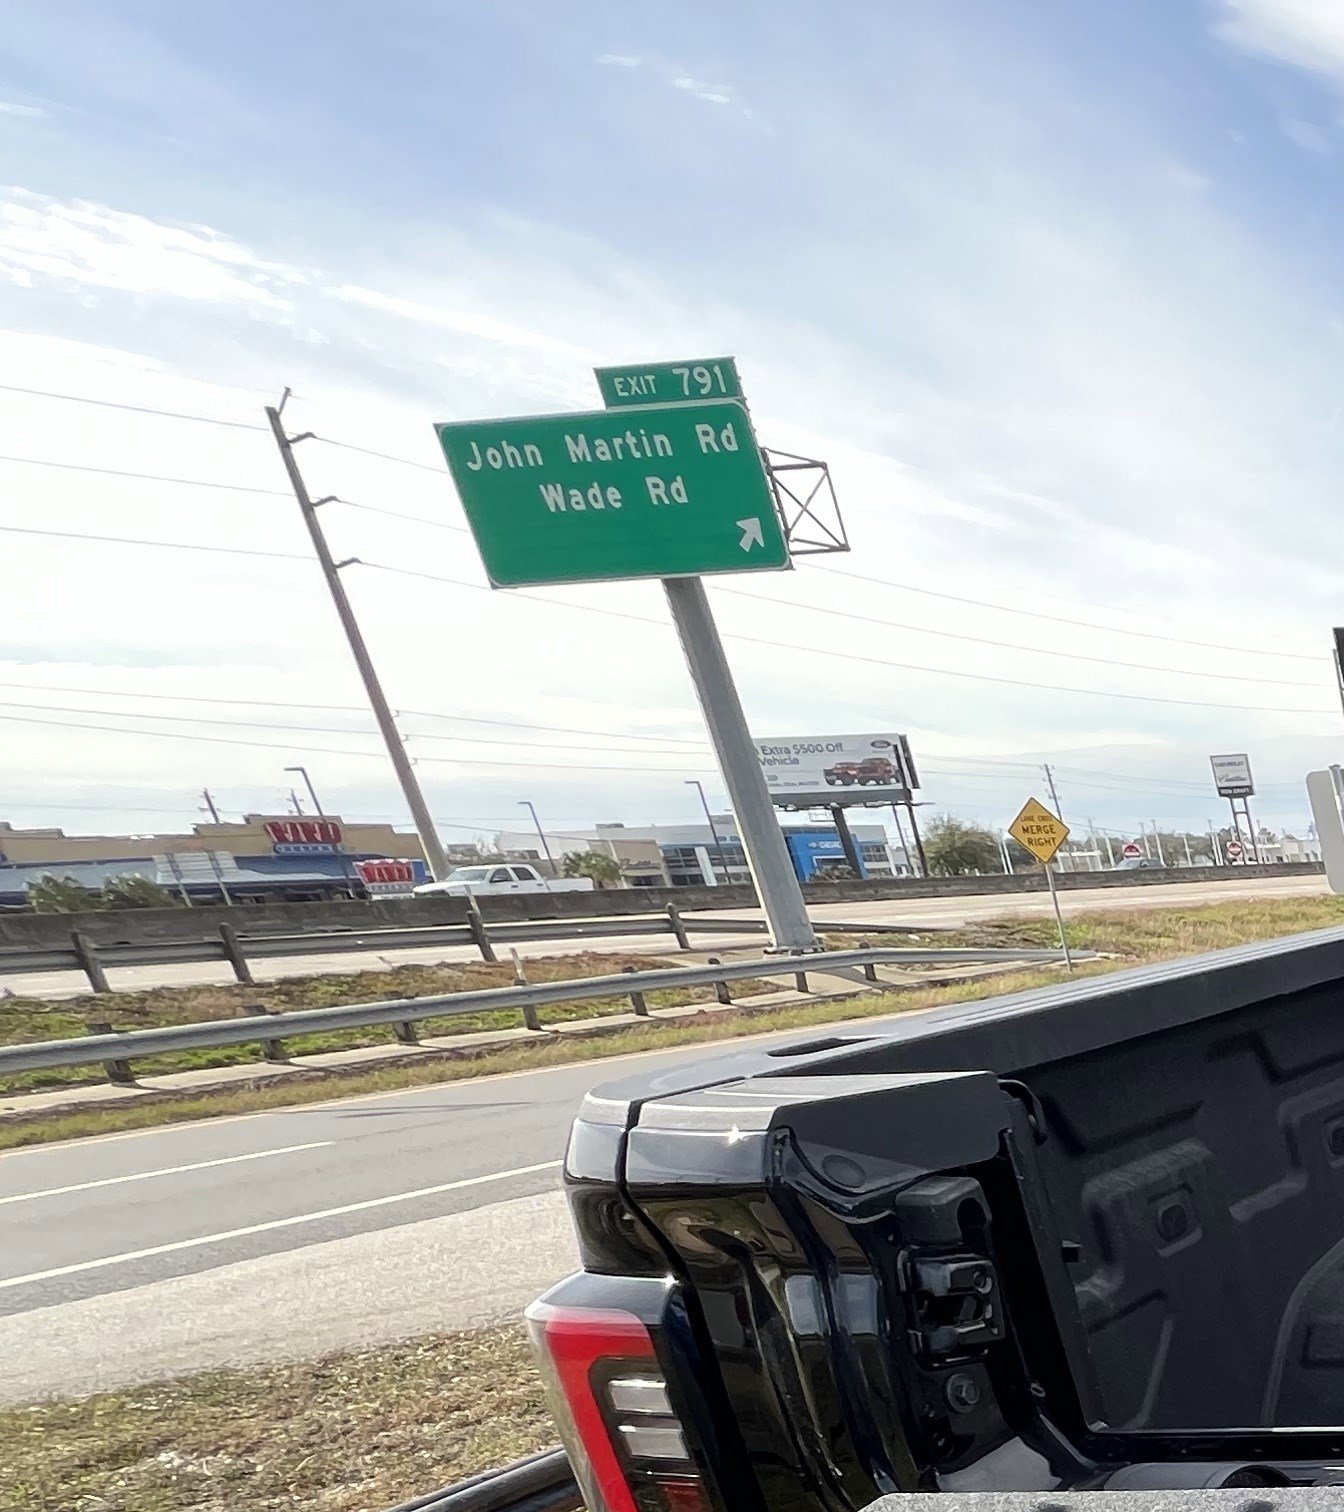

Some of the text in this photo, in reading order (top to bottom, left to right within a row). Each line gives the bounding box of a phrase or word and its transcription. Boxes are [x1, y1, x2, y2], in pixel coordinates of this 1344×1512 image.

[613, 365, 729, 397] EXIT 791
[467, 422, 739, 471] John Martin Rd
[539, 475, 689, 513] Wade Rd
[761, 742, 843, 755] Extra $500 Off
[1021, 825, 1056, 834] MERGE
[1027, 837, 1056, 847] RIGHT
